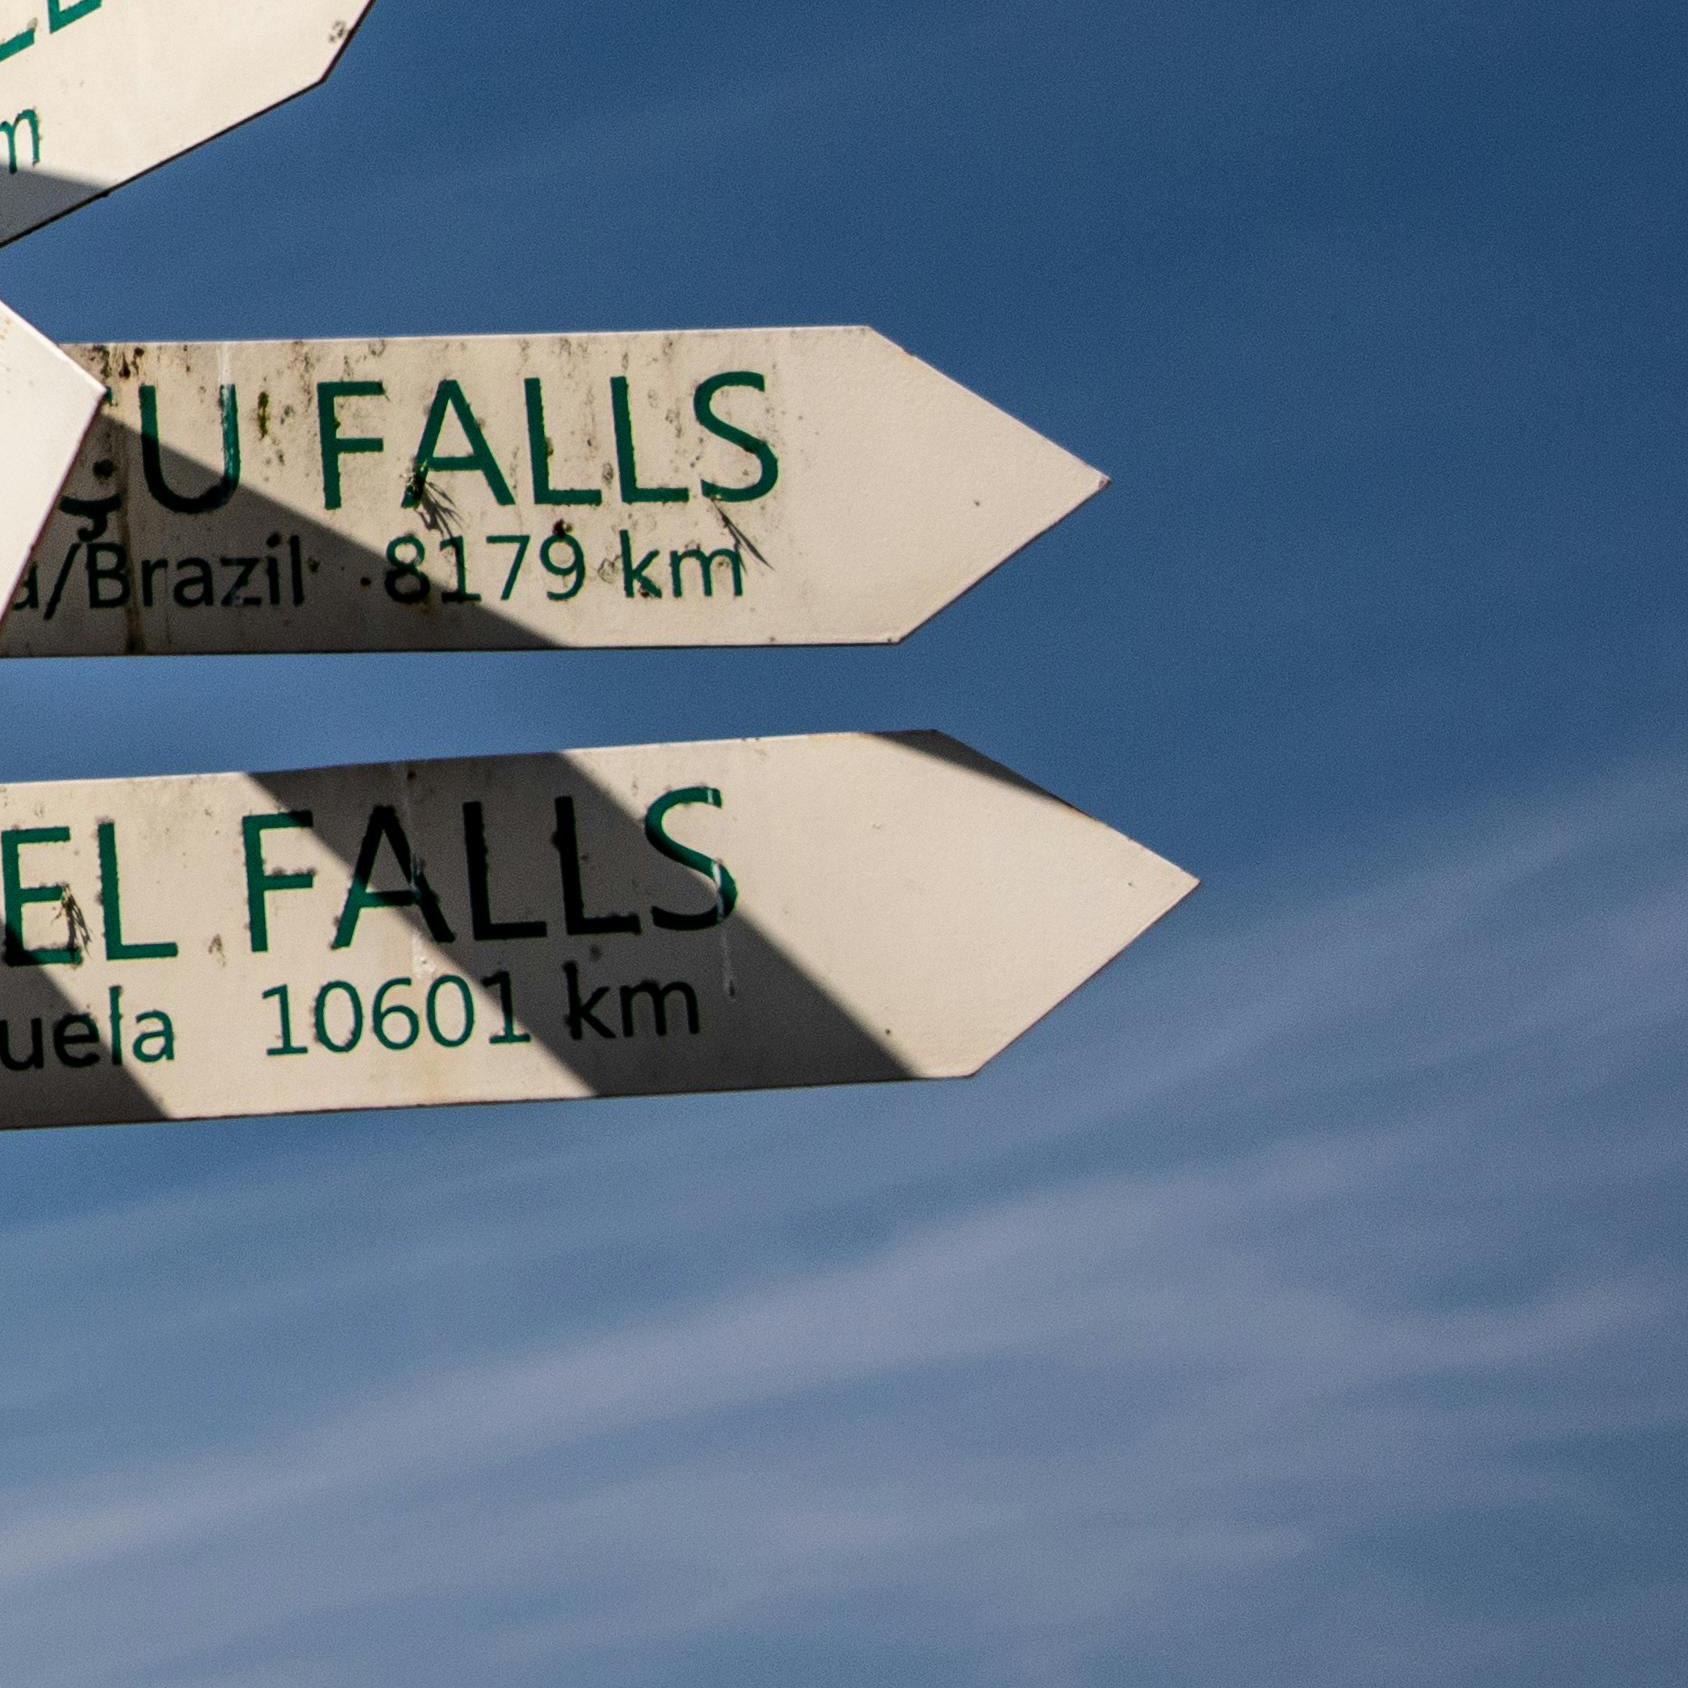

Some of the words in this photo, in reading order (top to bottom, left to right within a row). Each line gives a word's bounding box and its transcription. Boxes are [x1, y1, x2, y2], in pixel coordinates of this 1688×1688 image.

[316, 370, 780, 511] FALLS
[384, 532, 586, 605] 8179
[622, 528, 744, 601] km
[241, 786, 739, 952] FALLS
[260, 970, 531, 1057] 10601
[565, 960, 700, 1040] km
